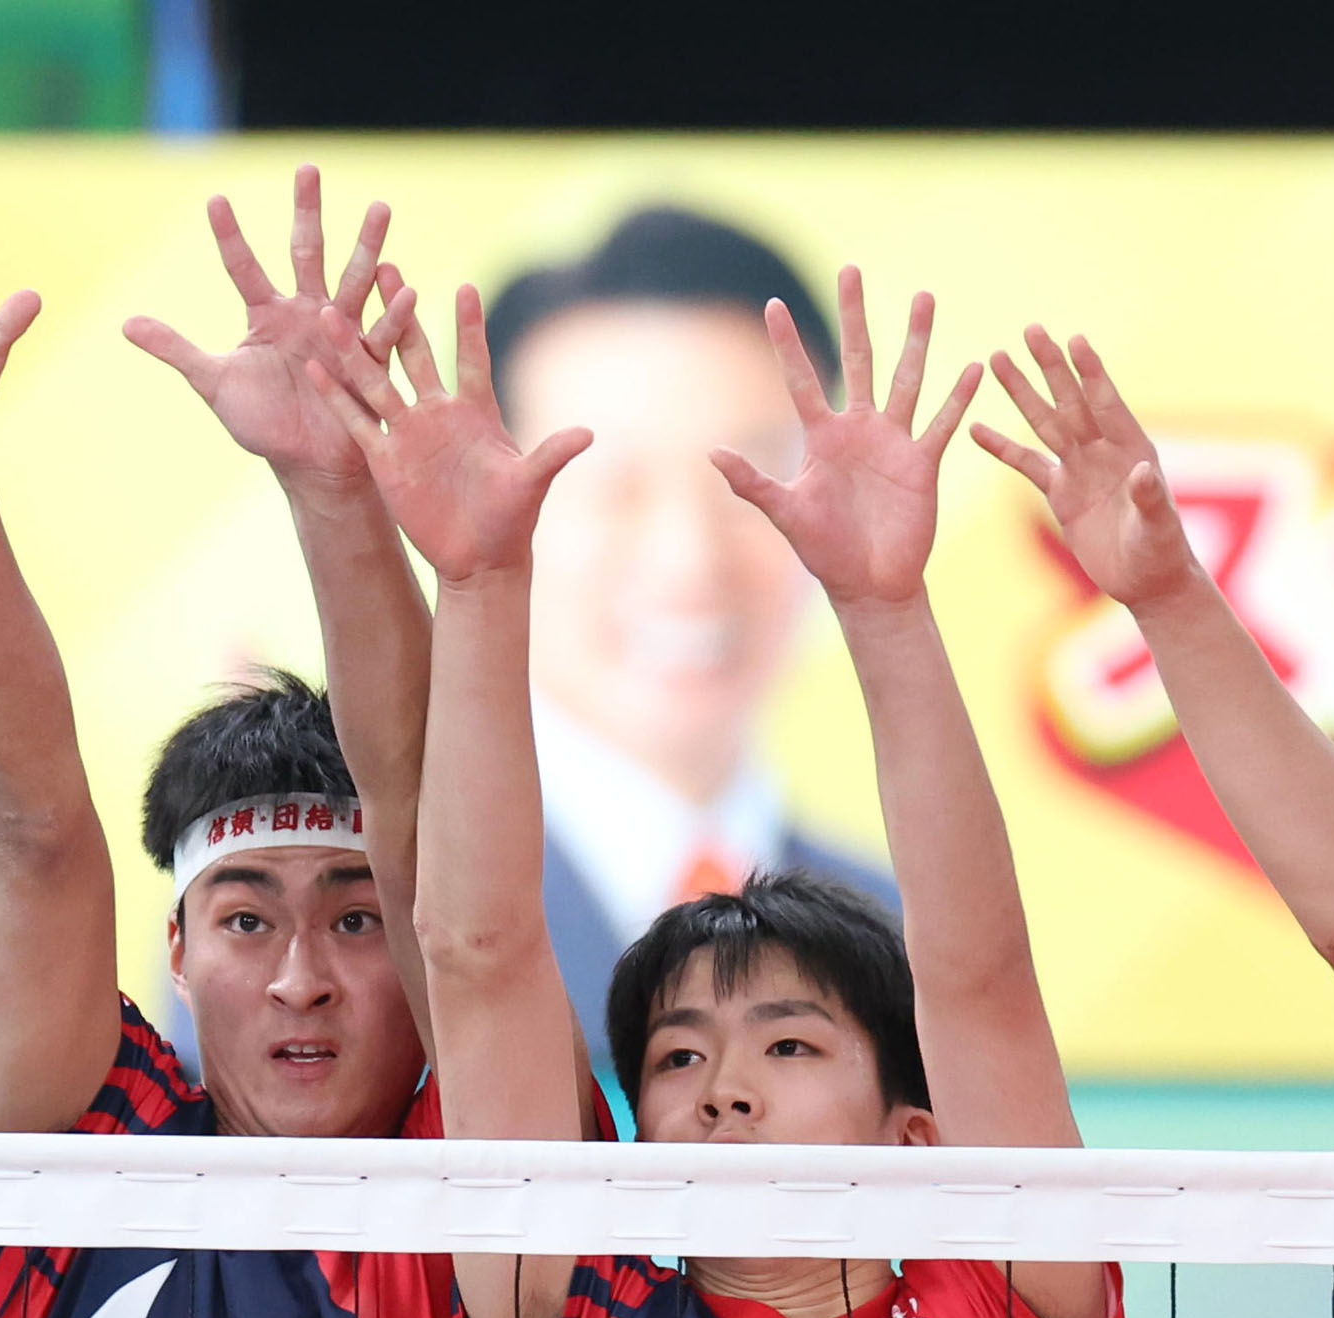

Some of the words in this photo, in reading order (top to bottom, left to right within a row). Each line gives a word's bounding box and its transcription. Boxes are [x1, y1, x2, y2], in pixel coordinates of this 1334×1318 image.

[207, 803, 363, 847] 信頼・団結・
